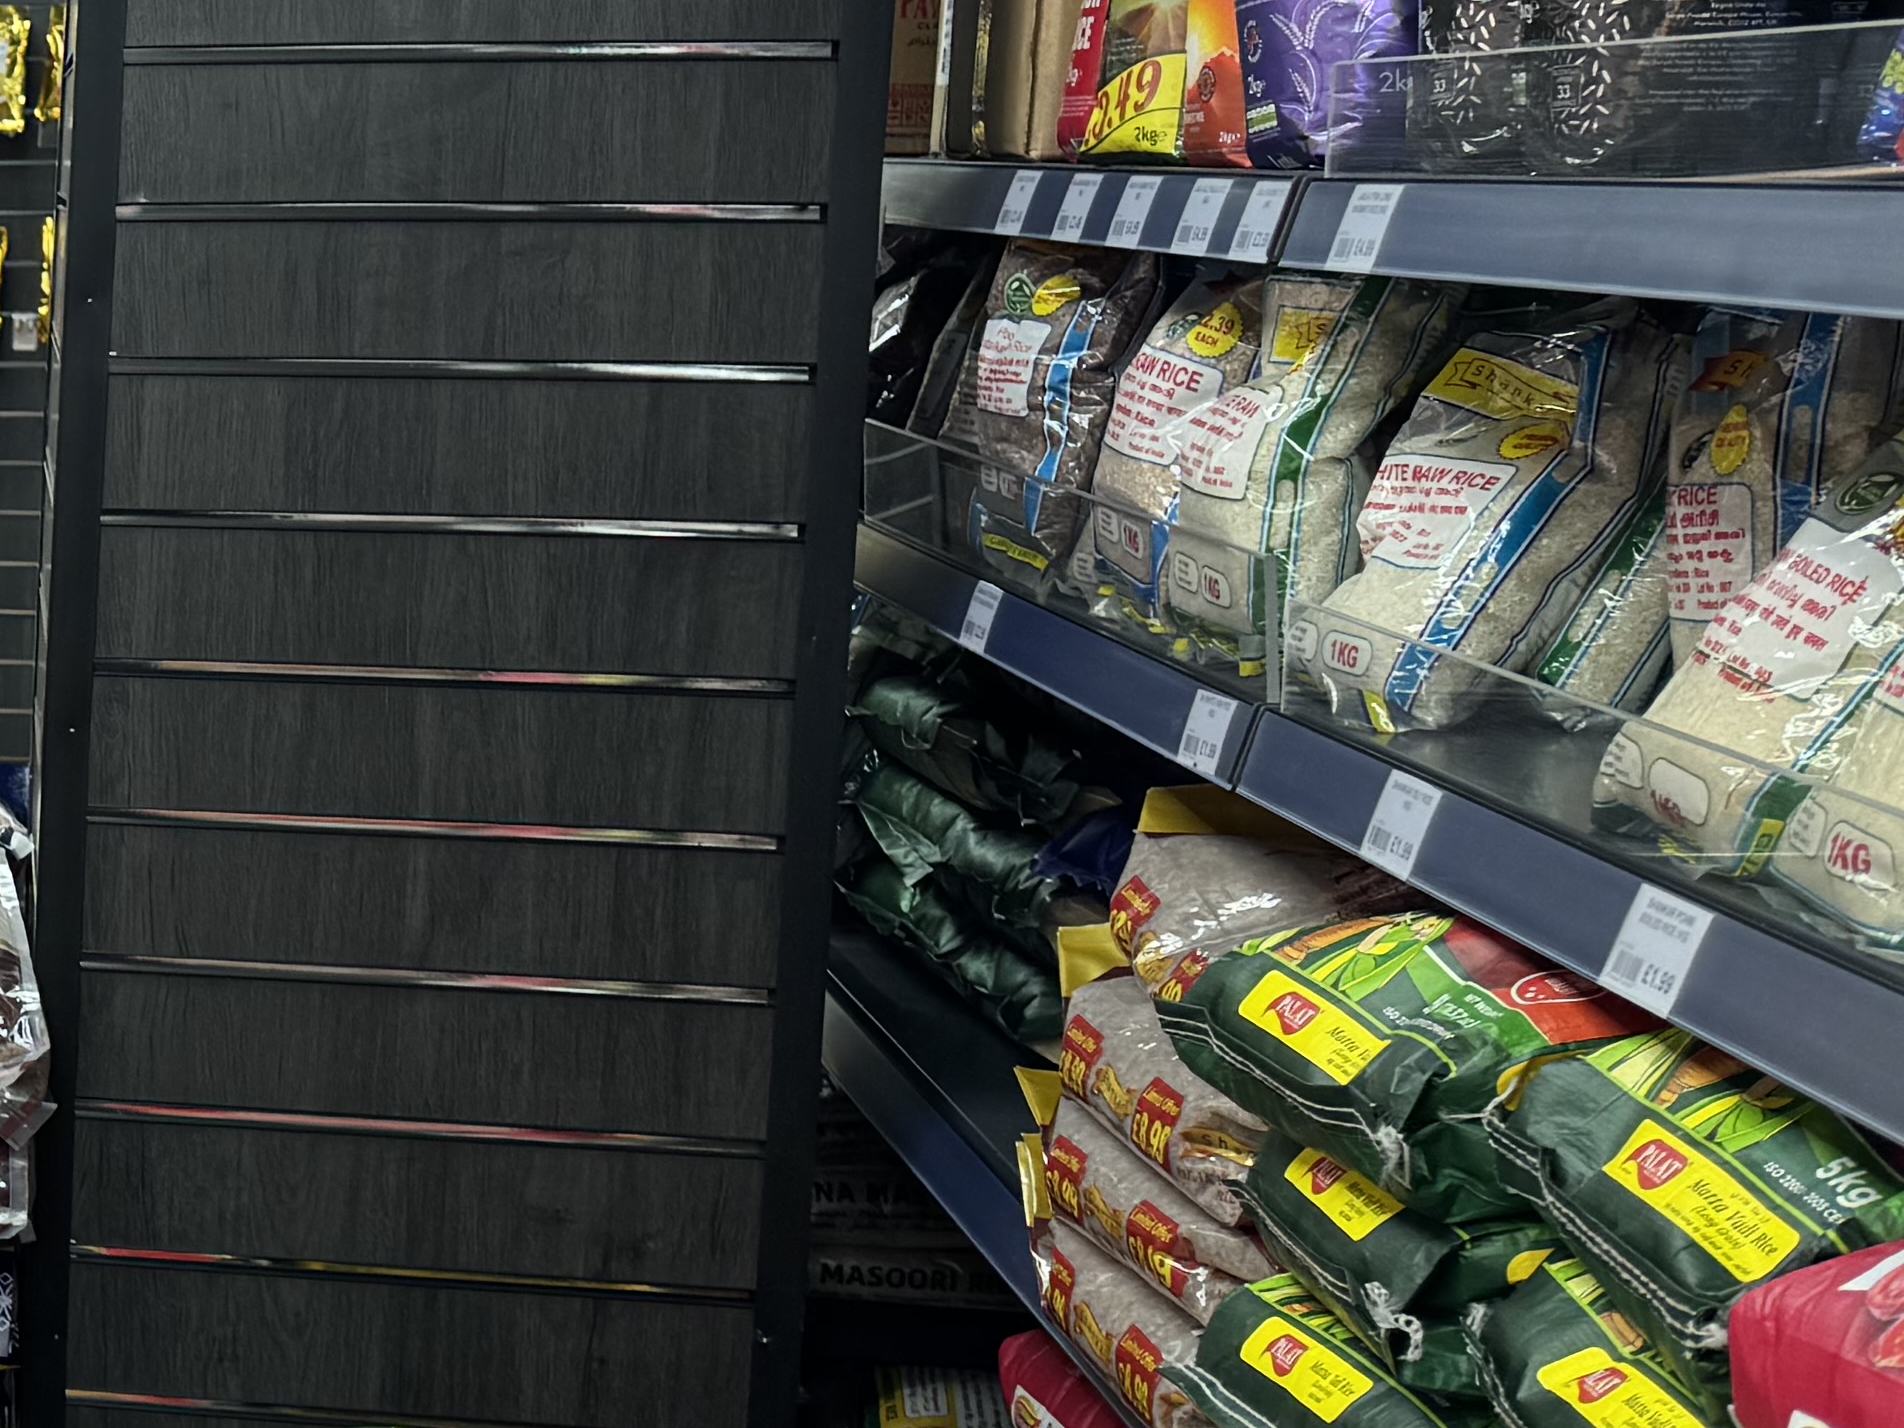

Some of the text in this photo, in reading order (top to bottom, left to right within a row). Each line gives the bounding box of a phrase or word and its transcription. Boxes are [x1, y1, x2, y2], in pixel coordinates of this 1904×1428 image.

[1156, 356, 1204, 393] RICE
[1411, 464, 1501, 491] RAW RICE
[1677, 486, 1718, 505] RICE
[1828, 575, 1867, 605] RICE
[1330, 639, 1359, 668] 1KG
[1829, 832, 1872, 874] 1KG
[1640, 962, 1676, 995] £1.99
[1278, 993, 1318, 1032] PALAT
[1637, 1143, 1685, 1179] PALAT
[1816, 1155, 1882, 1208] 5kg
[819, 1262, 959, 1292] MASOORI
